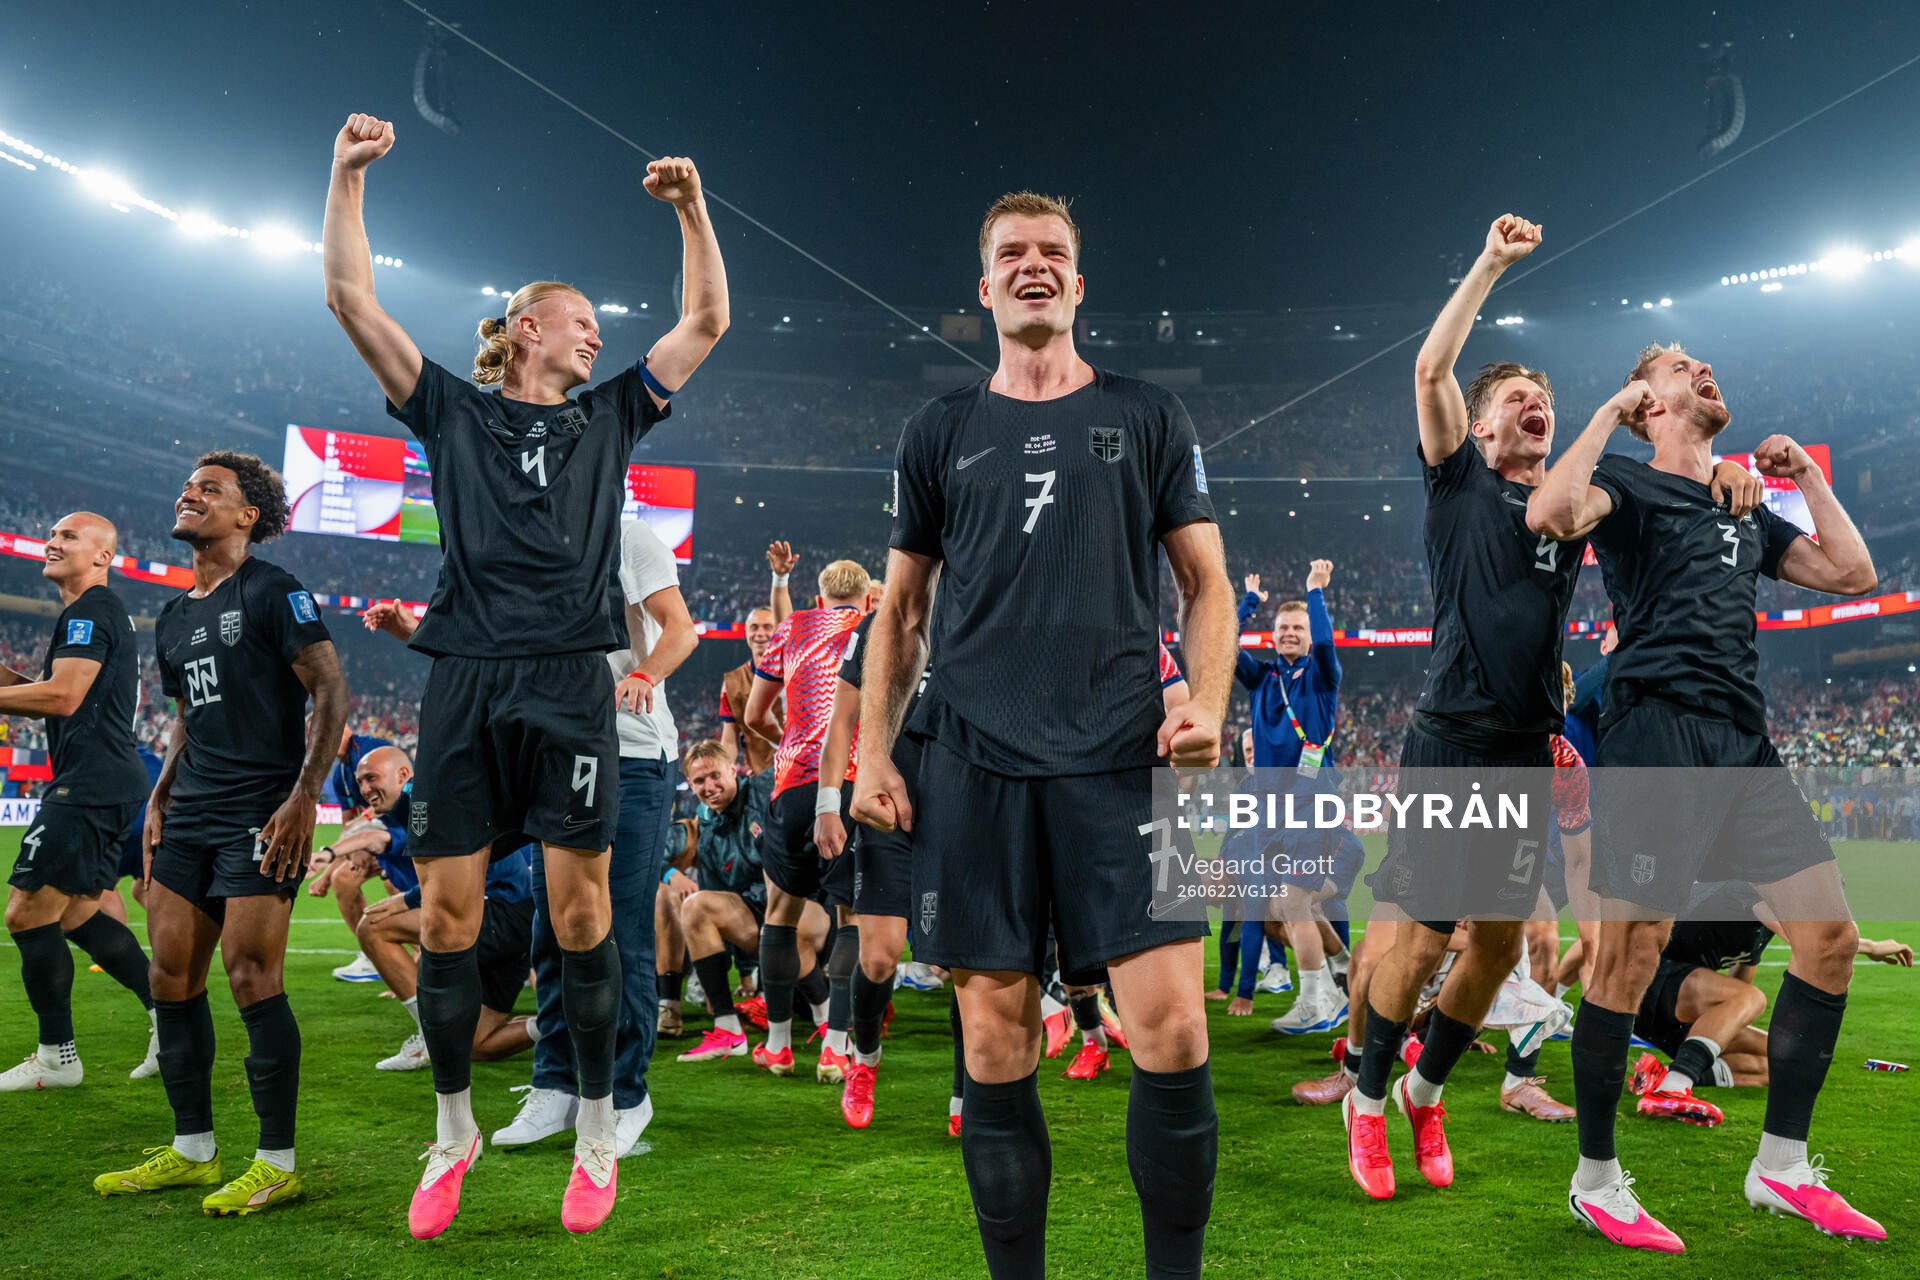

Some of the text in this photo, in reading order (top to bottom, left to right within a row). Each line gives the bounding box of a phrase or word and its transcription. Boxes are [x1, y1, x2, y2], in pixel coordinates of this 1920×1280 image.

[1022, 470, 1056, 534] 7
[1716, 522, 1740, 567] 3
[184, 655, 222, 707] 22
[571, 755, 598, 807] 9
[23, 824, 46, 861] 4
[1137, 817, 1178, 892] 7
[1508, 839, 1539, 885] 5
